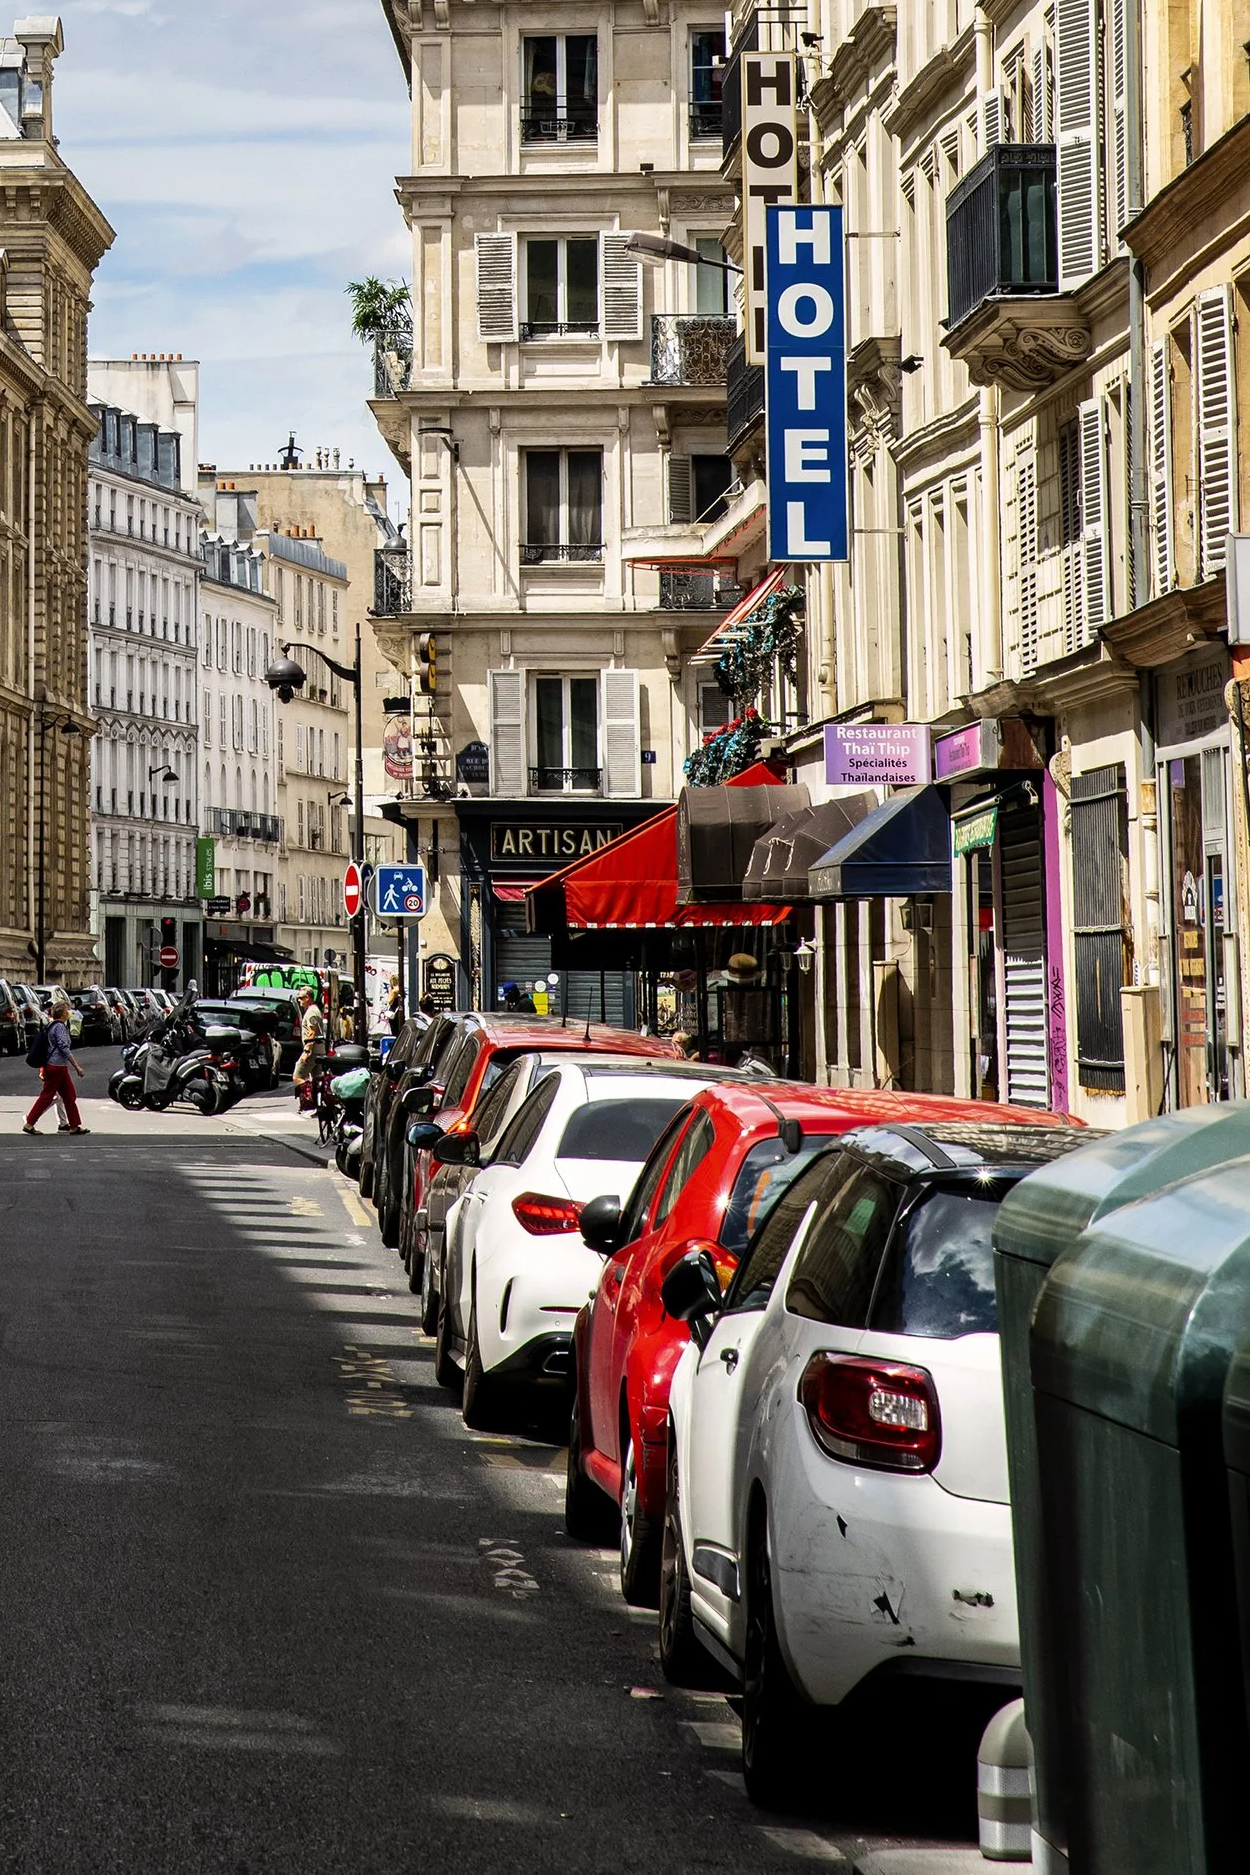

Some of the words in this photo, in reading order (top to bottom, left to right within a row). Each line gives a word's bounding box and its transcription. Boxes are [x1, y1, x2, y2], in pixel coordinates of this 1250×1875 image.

[746, 60, 794, 353] HOT
[776, 210, 835, 557] HOTEL
[836, 726, 918, 739] Restaurant
[842, 742, 876, 755] Thaï
[879, 741, 911, 757] Thip
[644, 752, 651, 762] 9
[848, 757, 908, 769] Spécialités
[840, 772, 916, 783] Thaïlandaises
[502, 829, 612, 855] ARTISAN
[203, 873, 213, 890] ibis
[408, 899, 419, 907] 20
